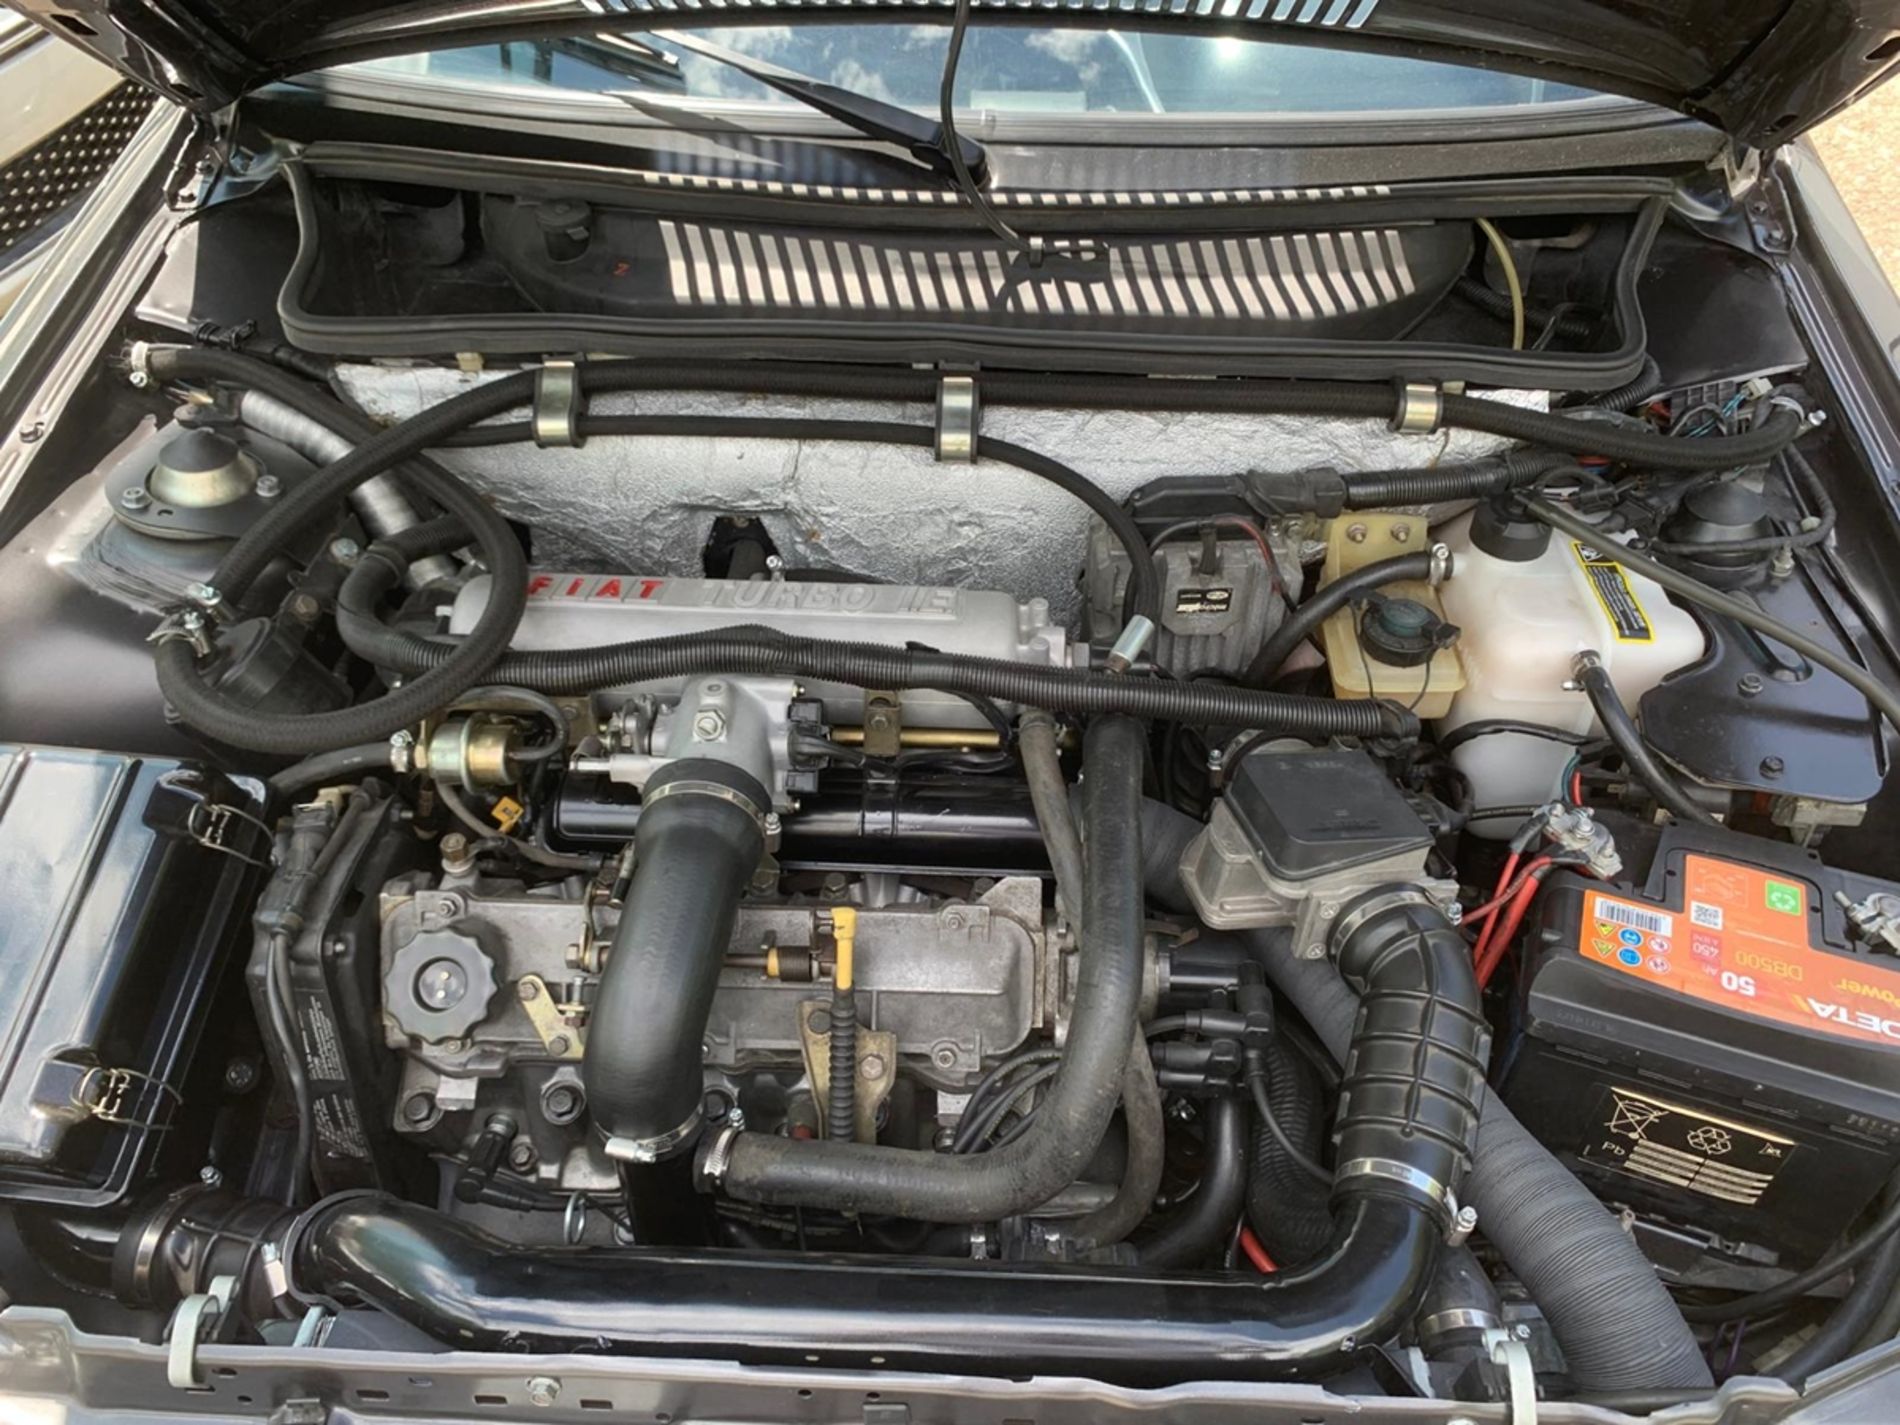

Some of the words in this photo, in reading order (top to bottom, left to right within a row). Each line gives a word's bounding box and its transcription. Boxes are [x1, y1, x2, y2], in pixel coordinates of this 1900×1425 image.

[527, 576, 663, 598] FIAT
[702, 582, 876, 614] TURBO
[1692, 942, 1719, 958] 450
[1734, 950, 1803, 980] DB500
[1721, 971, 1756, 997] 50
[1602, 1141, 1625, 1155] Pb
